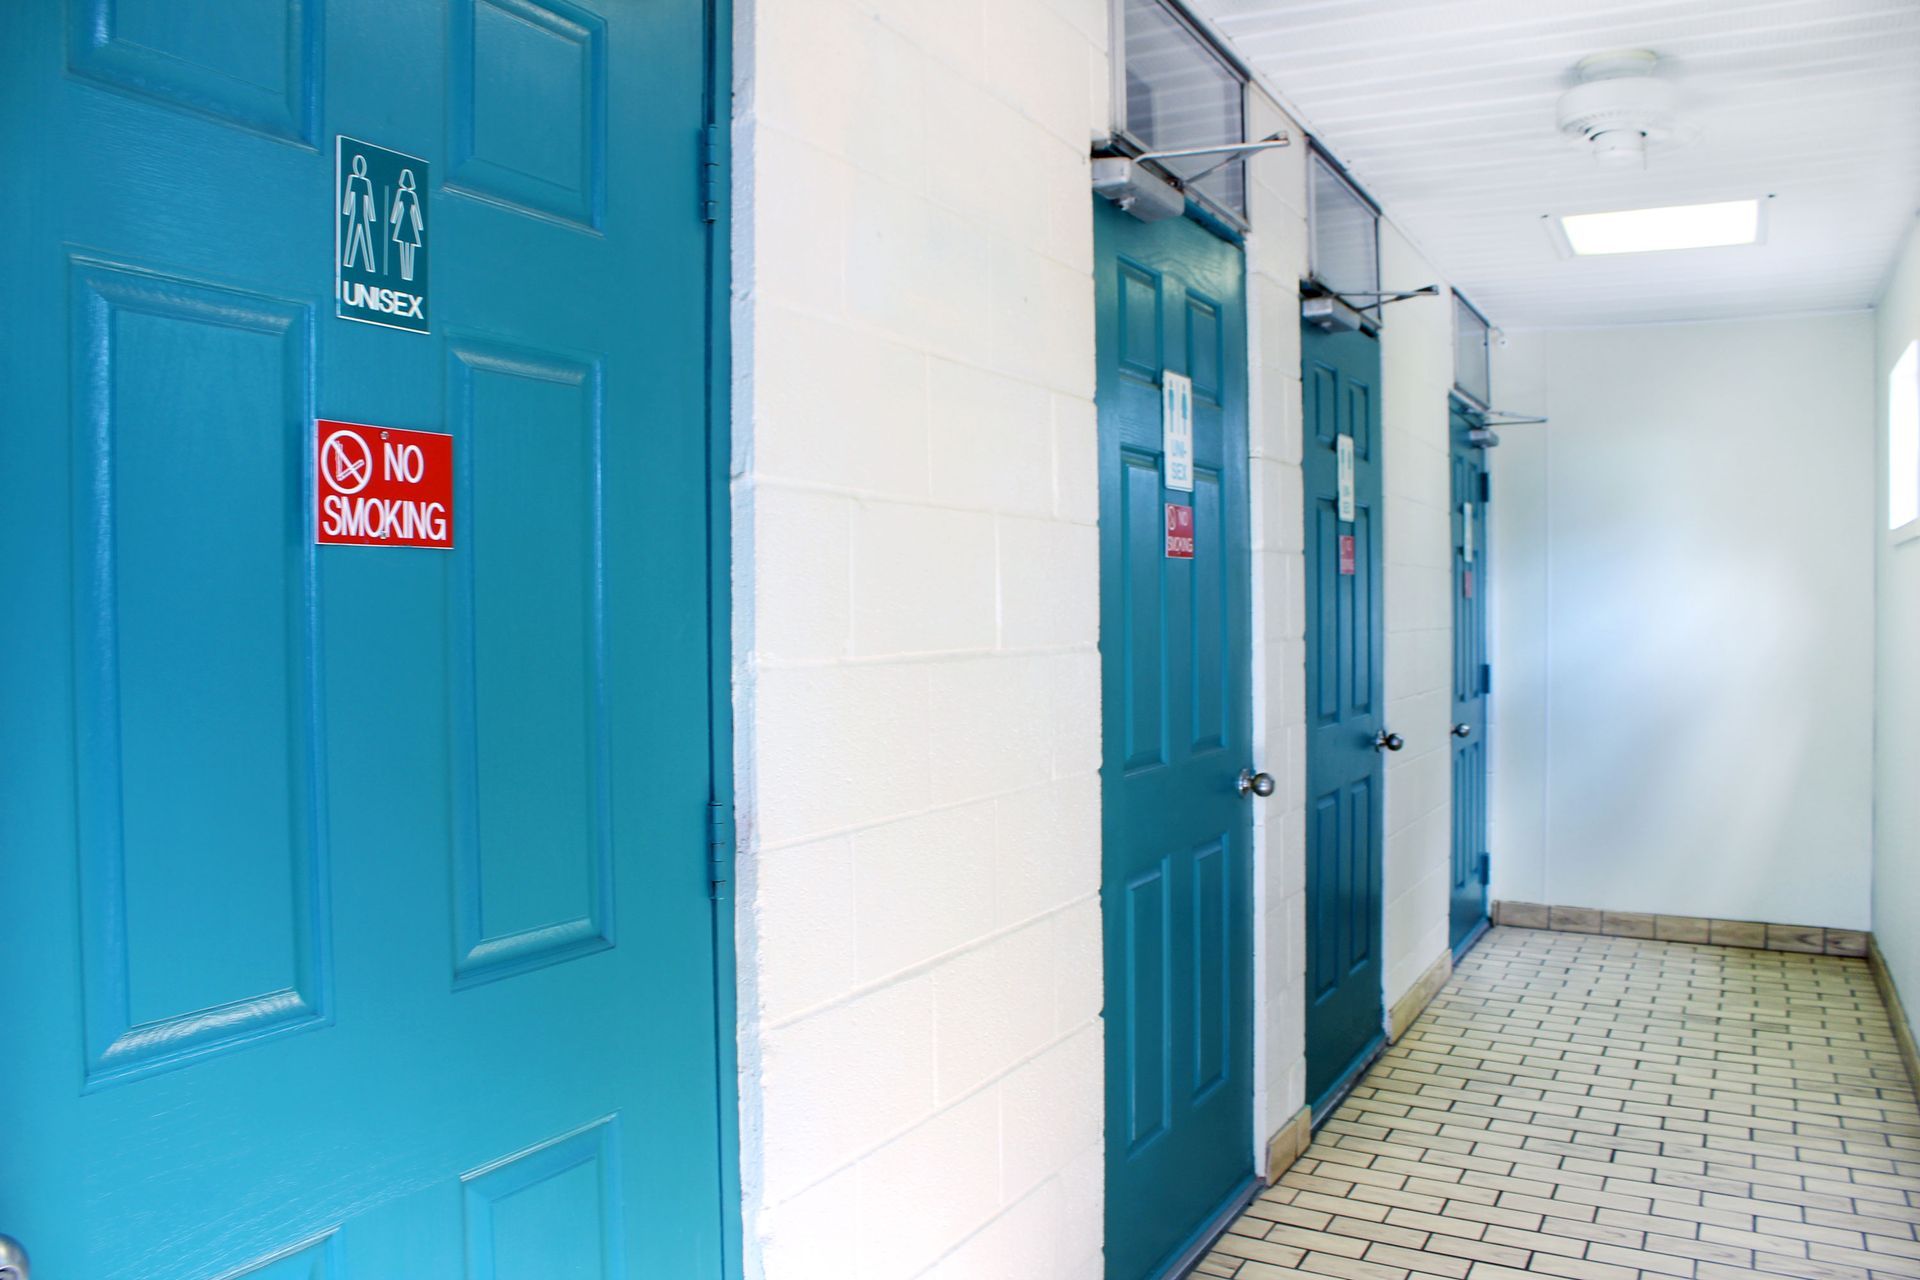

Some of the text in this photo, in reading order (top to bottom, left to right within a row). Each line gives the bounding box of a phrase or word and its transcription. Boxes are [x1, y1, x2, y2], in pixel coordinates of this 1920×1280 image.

[343, 280, 424, 320] UNISEX
[384, 442, 424, 484] NO
[1171, 462, 1187, 480] SEX
[322, 495, 446, 541] SMOKING
